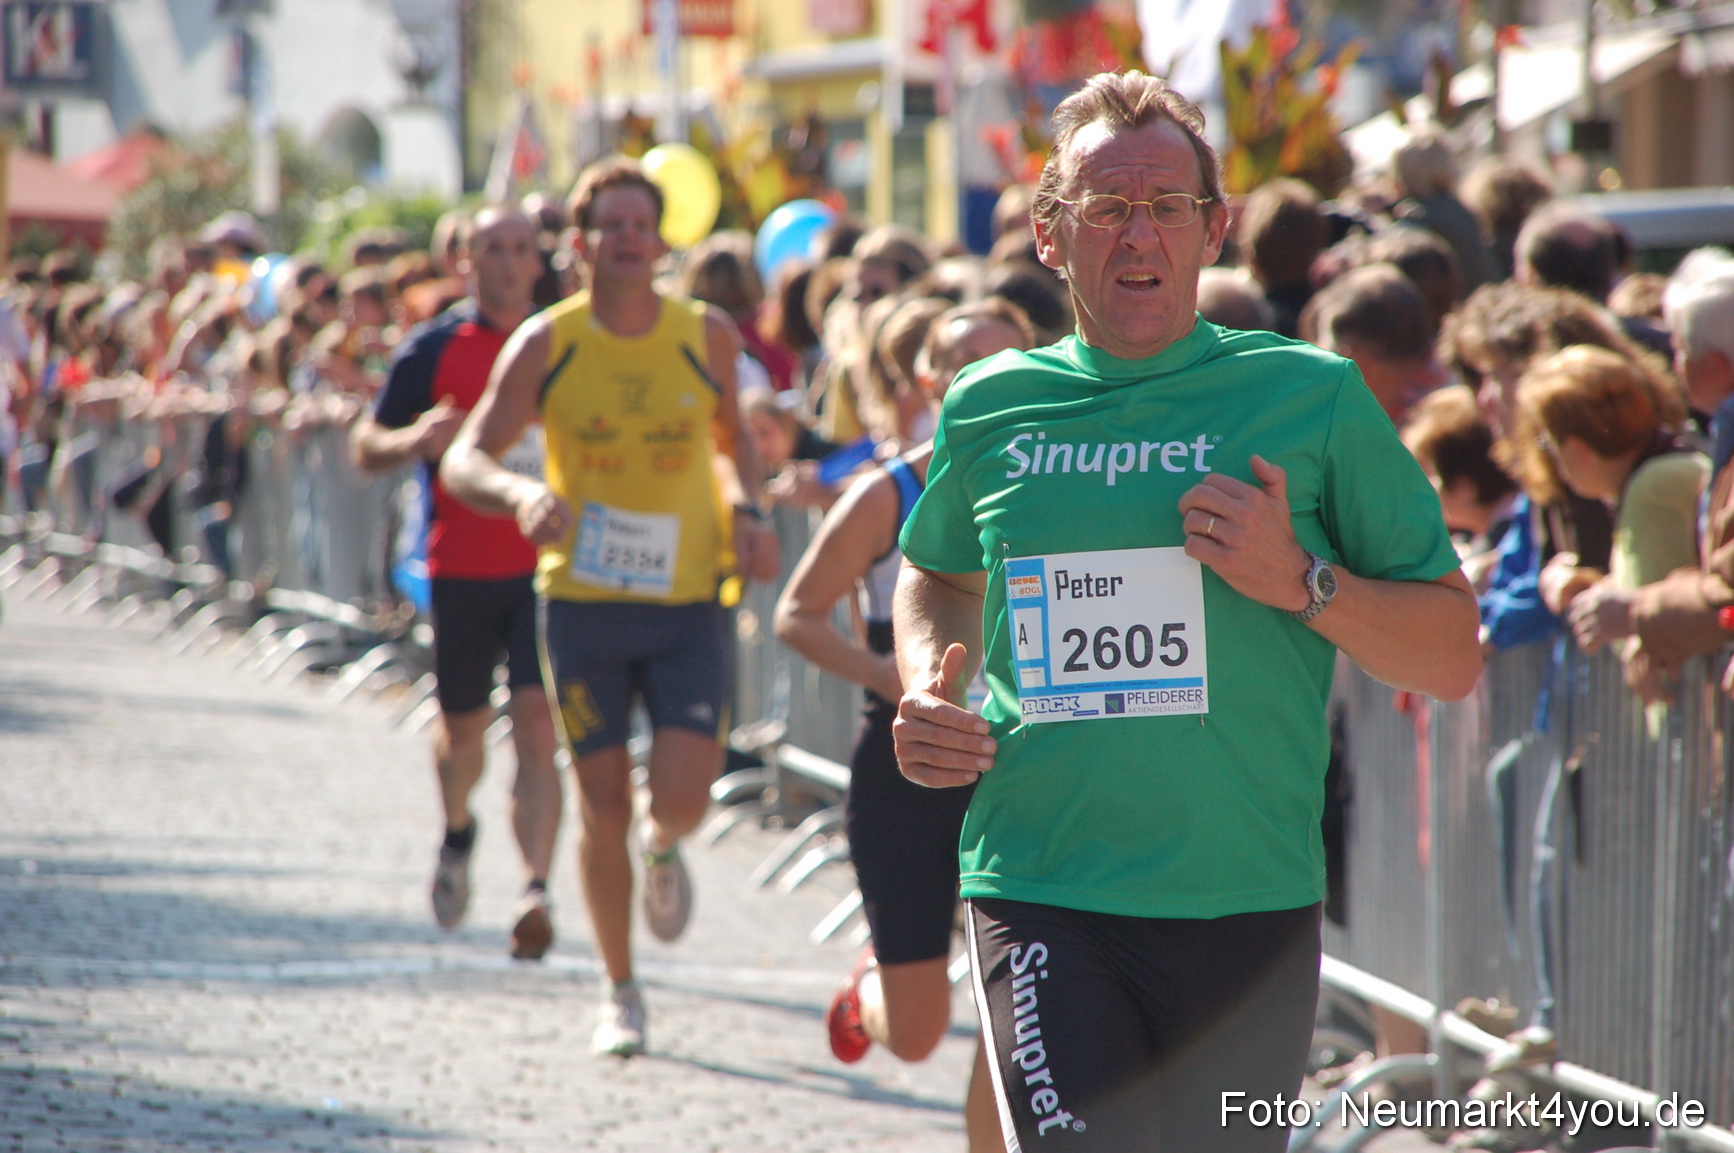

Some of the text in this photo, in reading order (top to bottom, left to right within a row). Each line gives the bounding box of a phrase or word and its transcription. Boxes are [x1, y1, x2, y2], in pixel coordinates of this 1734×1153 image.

[1054, 569, 1123, 601] Peter
[1018, 623, 1028, 646] A
[1062, 622, 1189, 673] 2605
[1021, 695, 1081, 716] BOCK
[1127, 689, 1204, 706] PFLEIDERER
[1127, 703, 1206, 714] AKTIENGESELLSCHAFT
